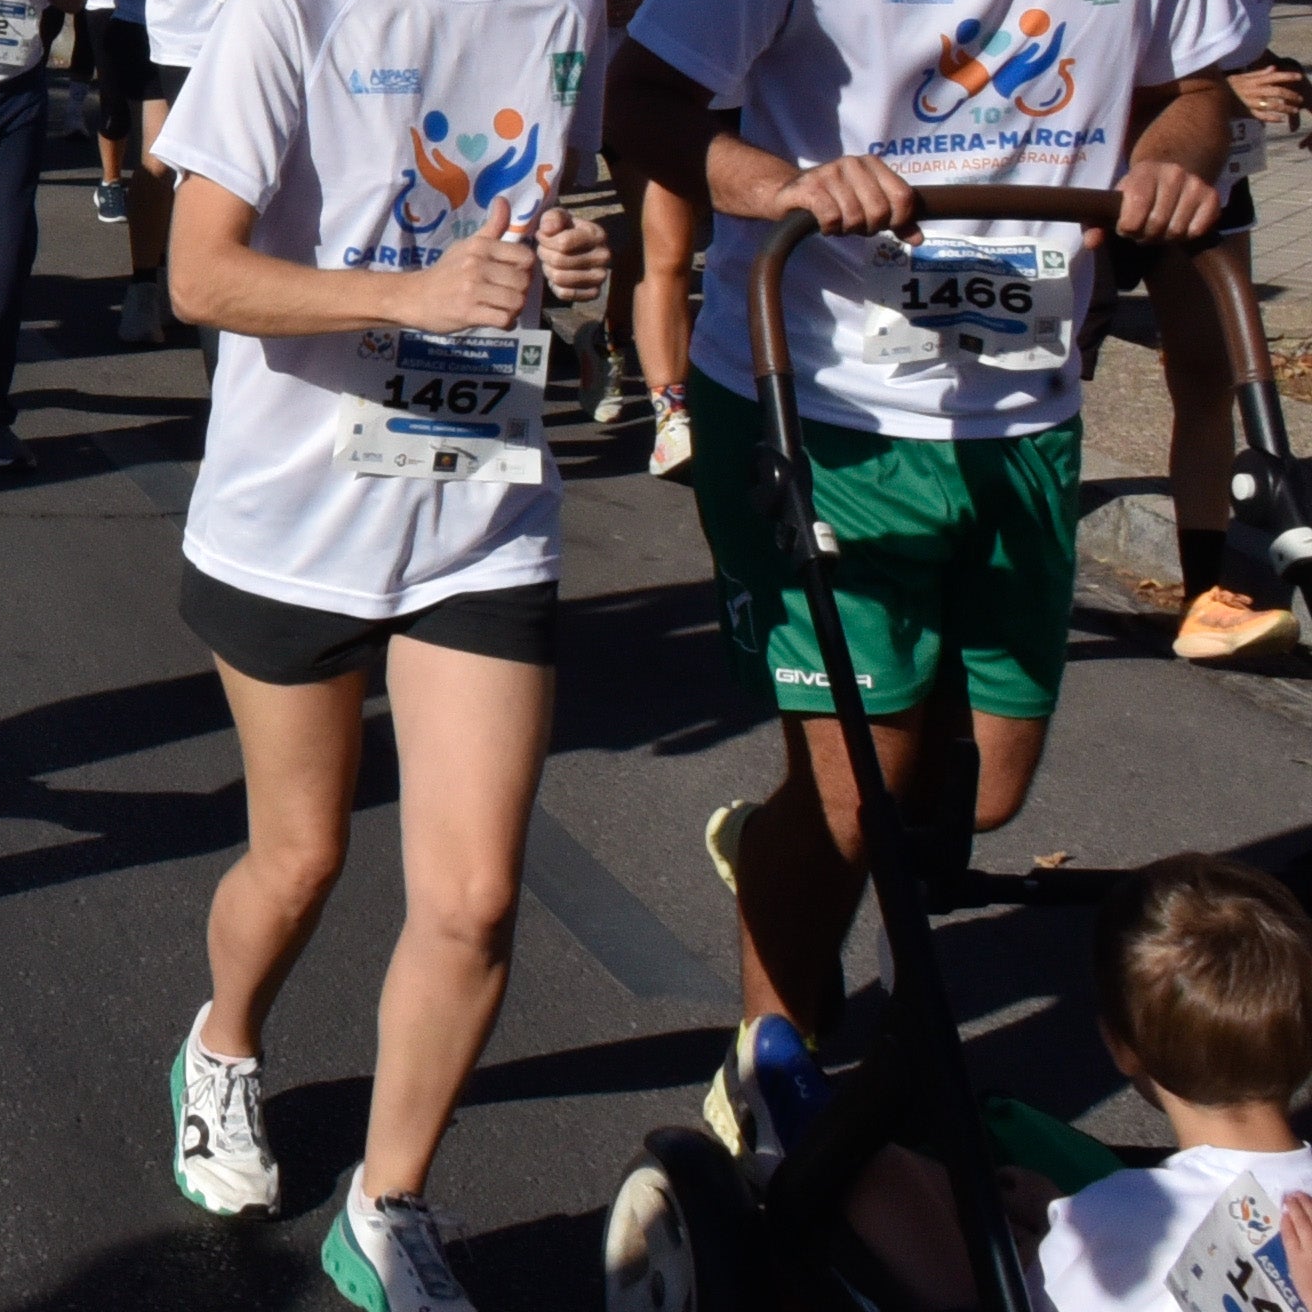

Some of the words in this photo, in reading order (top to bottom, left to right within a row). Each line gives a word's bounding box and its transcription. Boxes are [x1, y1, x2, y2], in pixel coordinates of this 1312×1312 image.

[370, 68, 420, 80] ASPACE
[868, 128, 1106, 157] CARRERA-MARCHA
[962, 154, 1011, 171] ASPAC
[901, 277, 1034, 314] 1466
[382, 374, 512, 416] 1467
[775, 668, 873, 689] GIVOA
